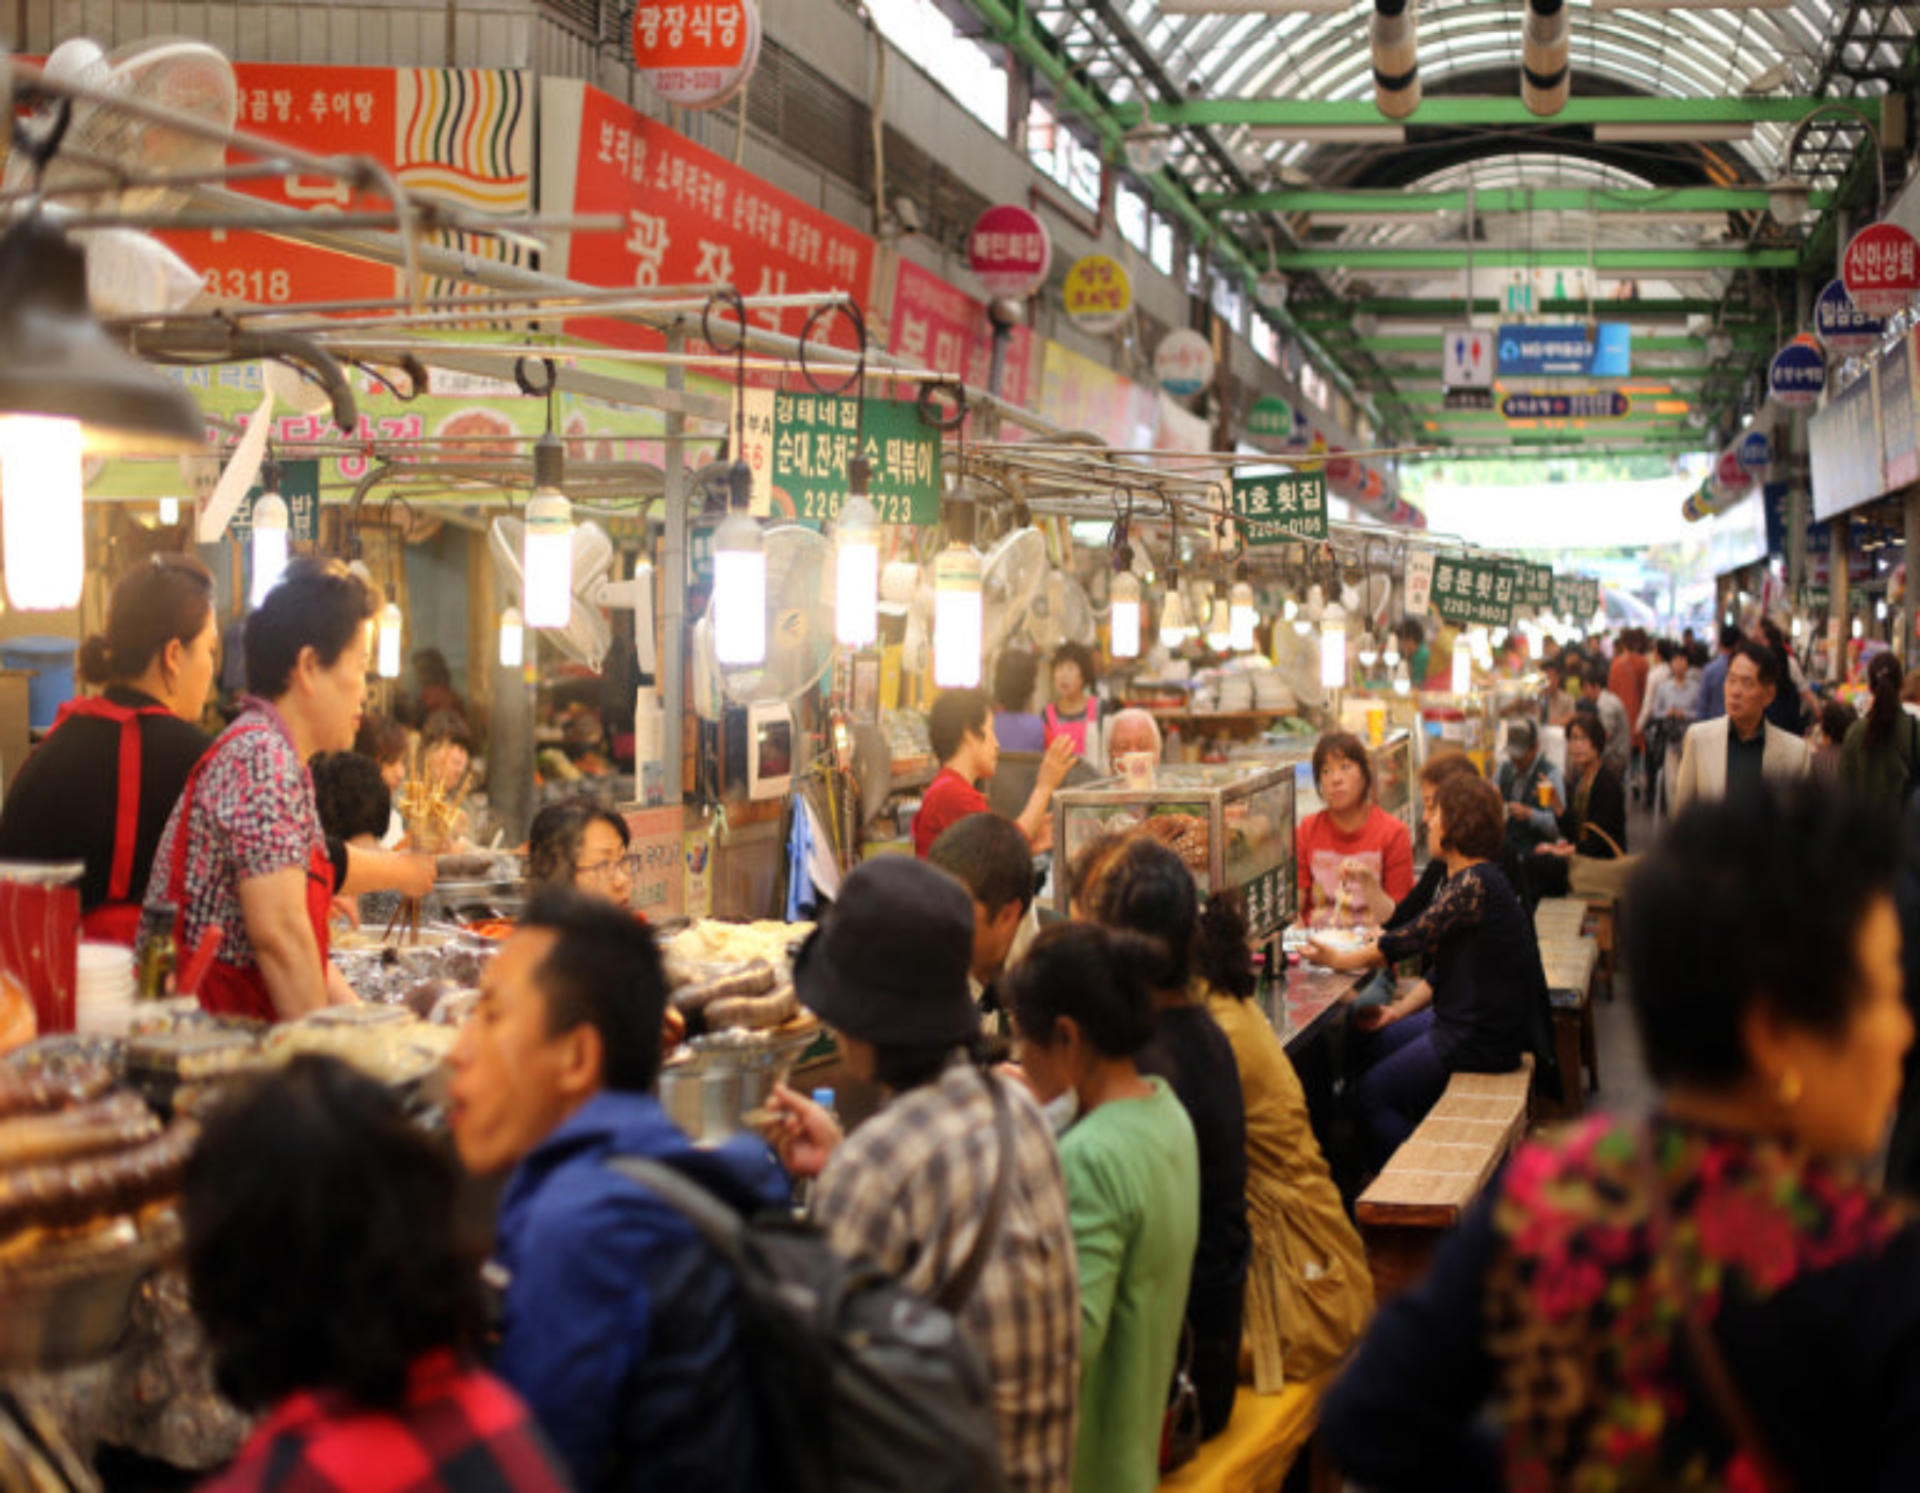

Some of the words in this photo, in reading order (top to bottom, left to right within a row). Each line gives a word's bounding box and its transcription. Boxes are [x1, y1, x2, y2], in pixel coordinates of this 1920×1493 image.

[638, 4, 739, 49] 광장식당
[309, 89, 374, 124] 추어탕
[804, 490, 911, 524] 226723
